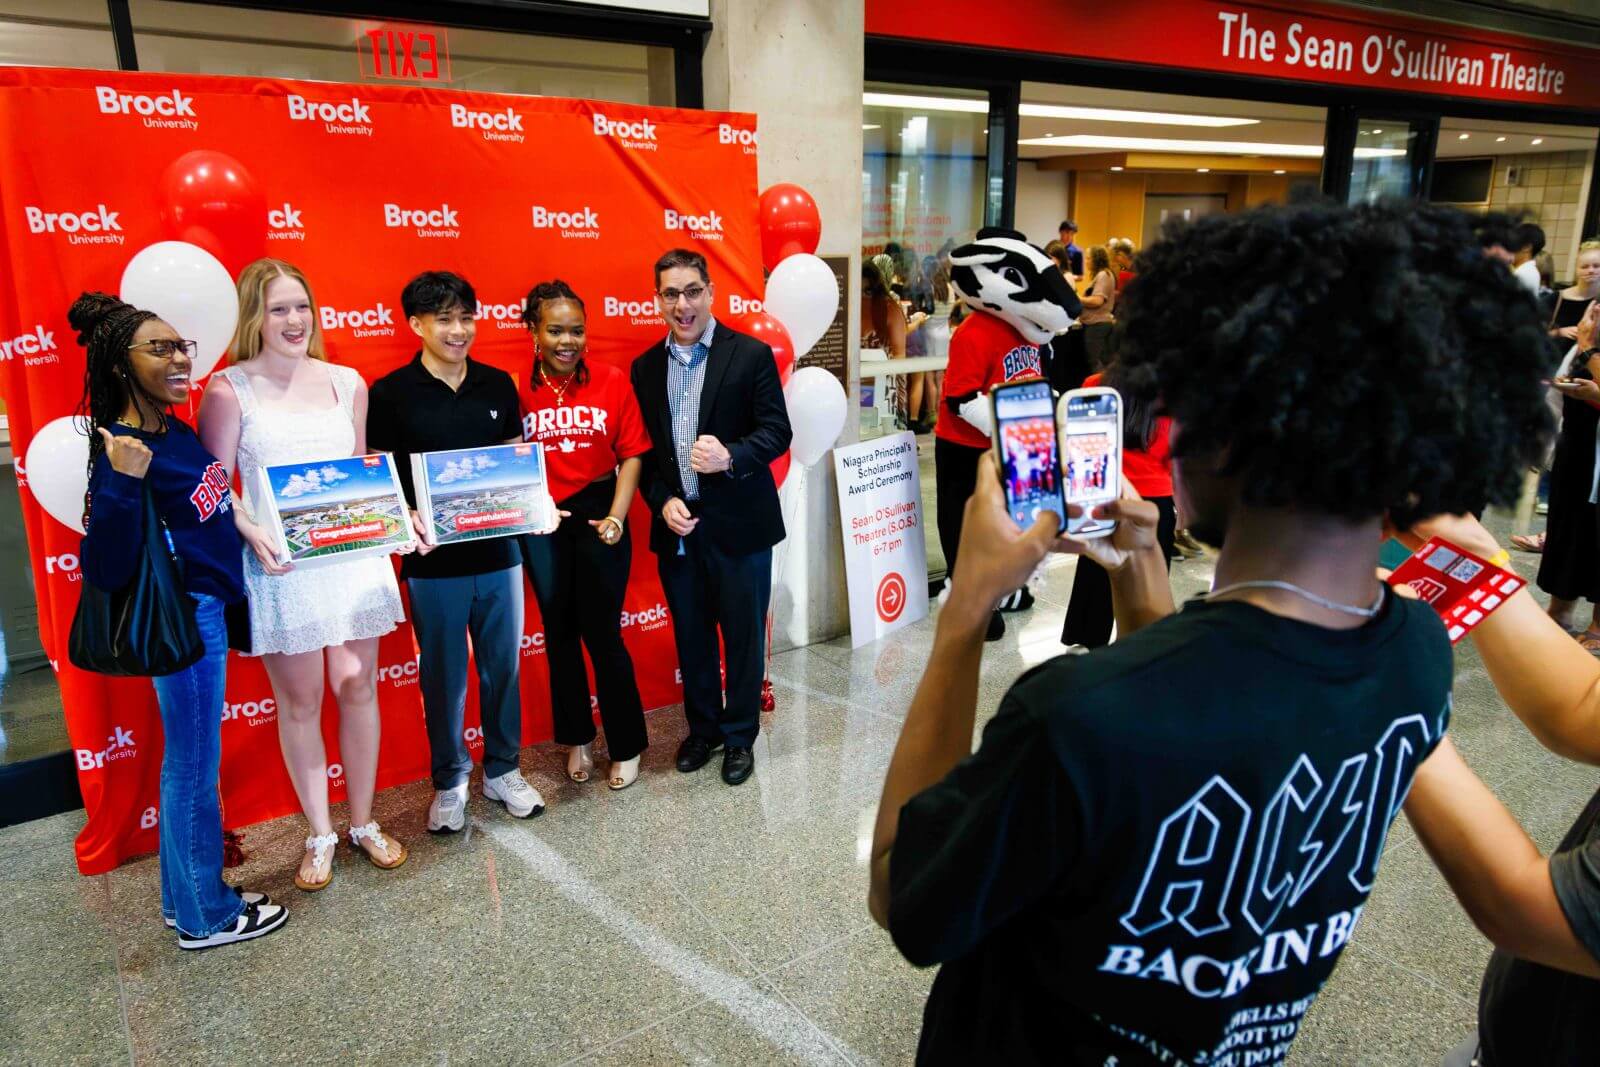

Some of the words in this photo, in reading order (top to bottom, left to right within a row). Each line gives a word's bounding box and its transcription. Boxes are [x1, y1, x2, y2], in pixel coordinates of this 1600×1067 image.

[1218, 11, 1276, 62] The
[1285, 23, 1353, 72] Sean
[1362, 34, 1484, 87] O'Sullivan
[1490, 52, 1565, 95] Theatre
[96, 86, 197, 117] Brock
[288, 94, 372, 124] Brock
[143, 117, 199, 131] University
[450, 104, 524, 132] Brock
[593, 113, 657, 140] Brock
[326, 123, 373, 136] University
[483, 130, 525, 144] University
[719, 123, 758, 145] Bro
[621, 139, 657, 152] University
[25, 204, 123, 234] Brock
[384, 204, 459, 228] Brock
[532, 206, 599, 230] Brock
[664, 209, 723, 231] Brock
[68, 233, 125, 245] University
[266, 230, 306, 241] iversity
[417, 228, 460, 239] University
[562, 229, 600, 239] University
[729, 294, 768, 315] Bro
[320, 302, 394, 330] Brock
[353, 326, 396, 338] University
[522, 405, 608, 442] BROCK
[537, 427, 595, 440] UNIVERSITY
[843, 454, 874, 469] Niagara
[875, 441, 912, 460] Principal's
[858, 459, 902, 479] Scholarship
[848, 479, 875, 497] Award
[876, 470, 913, 488] Ceremony
[852, 515, 874, 529] Sean
[875, 501, 916, 522] O'Sullivan
[853, 527, 887, 545] Theatre
[874, 543, 887, 556] 6-7
[889, 538, 903, 553] pm
[221, 698, 276, 722] Broc
[1098, 945, 1260, 999] BACK
[1255, 923, 1319, 975] IN
